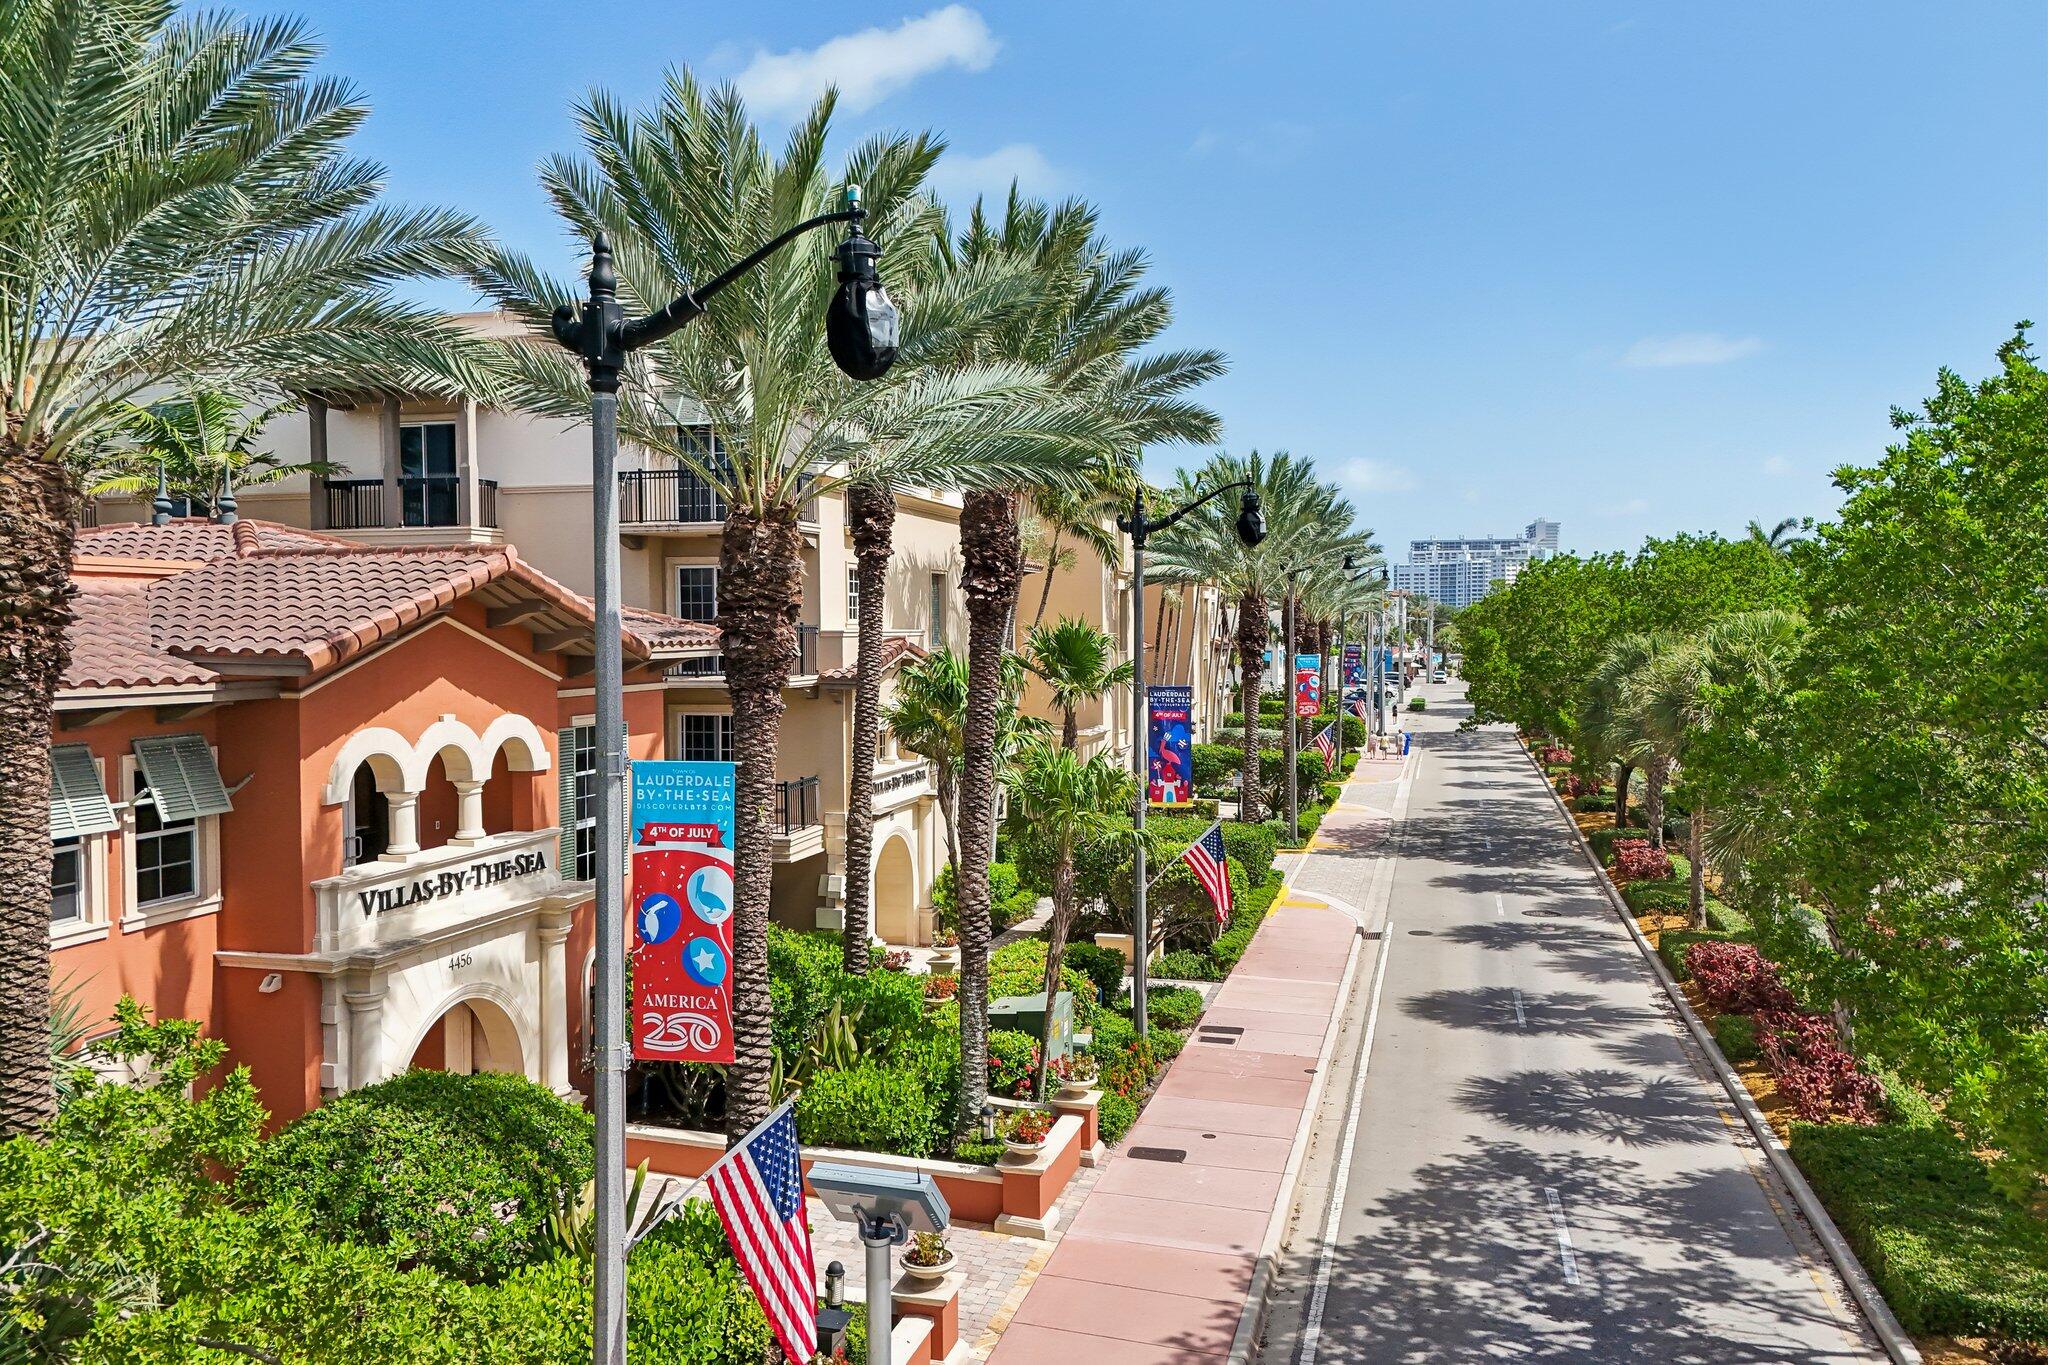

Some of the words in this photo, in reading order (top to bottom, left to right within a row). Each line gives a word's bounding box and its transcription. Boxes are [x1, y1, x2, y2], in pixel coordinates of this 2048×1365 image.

[1299, 705, 1318, 715] 250
[636, 774, 731, 787] LAUDERDALE
[636, 803, 731, 811] DISCOVERLBTSCOM
[649, 826, 667, 837] 4TH
[669, 827, 685, 838] OF
[687, 827, 714, 838] JULY
[448, 952, 473, 972] 4456
[642, 993, 718, 1010] AMERICA
[642, 1012, 722, 1053] 250
